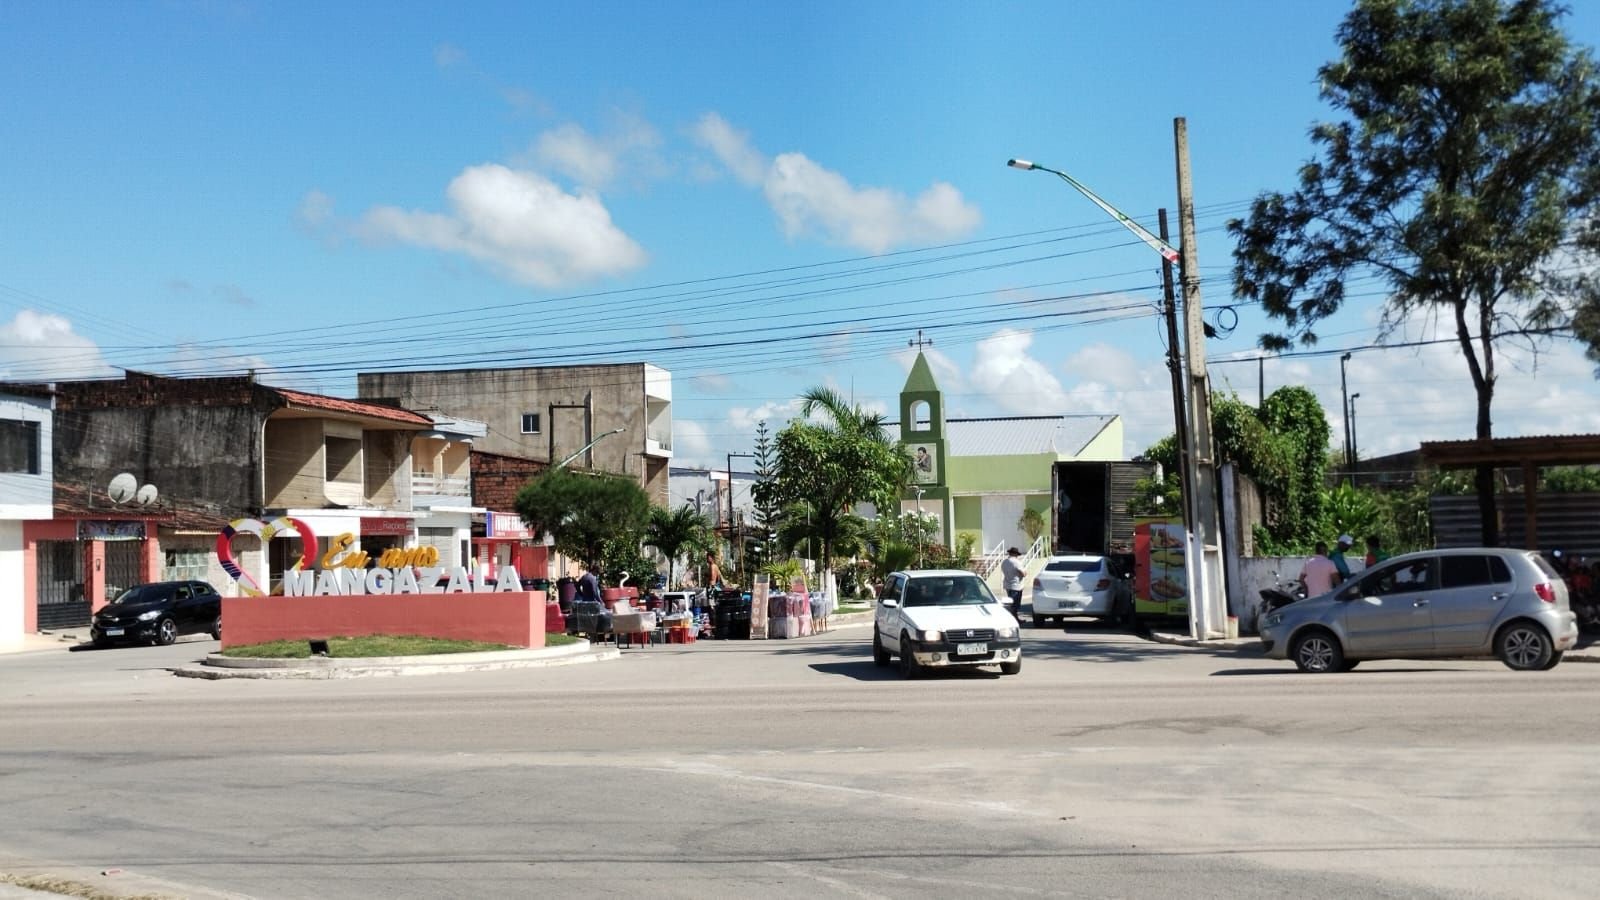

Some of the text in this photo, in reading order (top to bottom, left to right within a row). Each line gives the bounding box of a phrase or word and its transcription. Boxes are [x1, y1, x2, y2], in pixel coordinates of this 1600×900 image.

[321, 533, 439, 569] Eu amo
[284, 565, 524, 597] MANGAZALA
